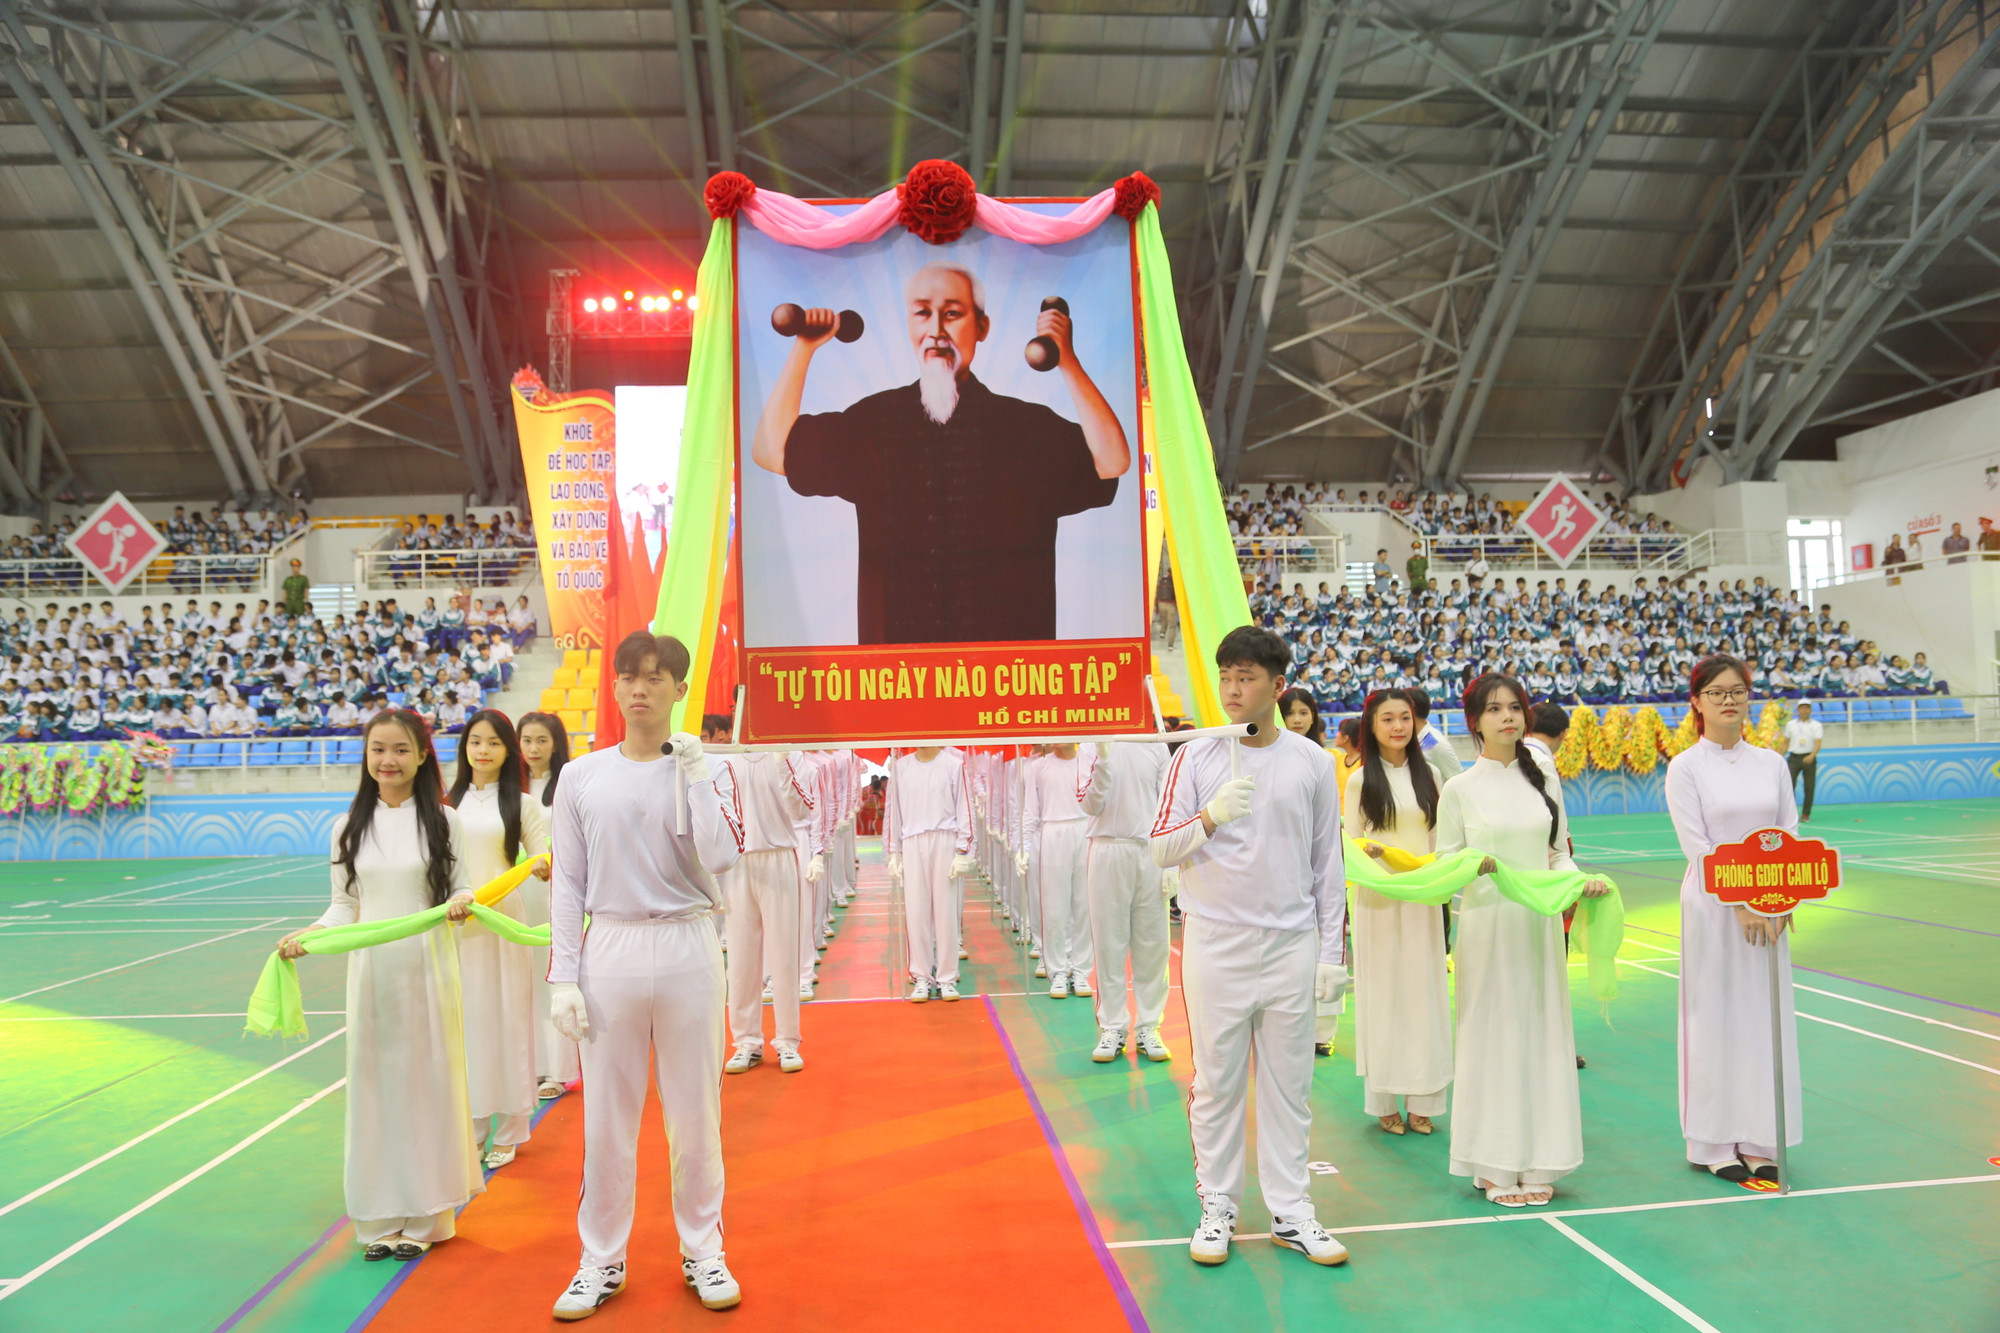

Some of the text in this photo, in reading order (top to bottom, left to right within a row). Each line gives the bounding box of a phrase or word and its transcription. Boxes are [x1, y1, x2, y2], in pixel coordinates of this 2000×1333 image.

[564, 417, 593, 440] KHỎE
[548, 446, 563, 470] ĐỂ
[565, 453, 587, 474] HỌC
[551, 483, 570, 499] LAO
[552, 509, 606, 533] XÂY DỰNG
[552, 536, 608, 563] VÀ BẢO VỆ
[574, 565, 602, 589] QUỐC
[811, 662, 851, 701] TÔI
[859, 661, 927, 700] NGÀY
[935, 659, 987, 698] NÀO
[994, 658, 1063, 696] CŨNG
[978, 707, 1130, 725] HỒ CHÍ MINH
[1714, 857, 1829, 890] PHÒNG GDĐT CAM LỘ
